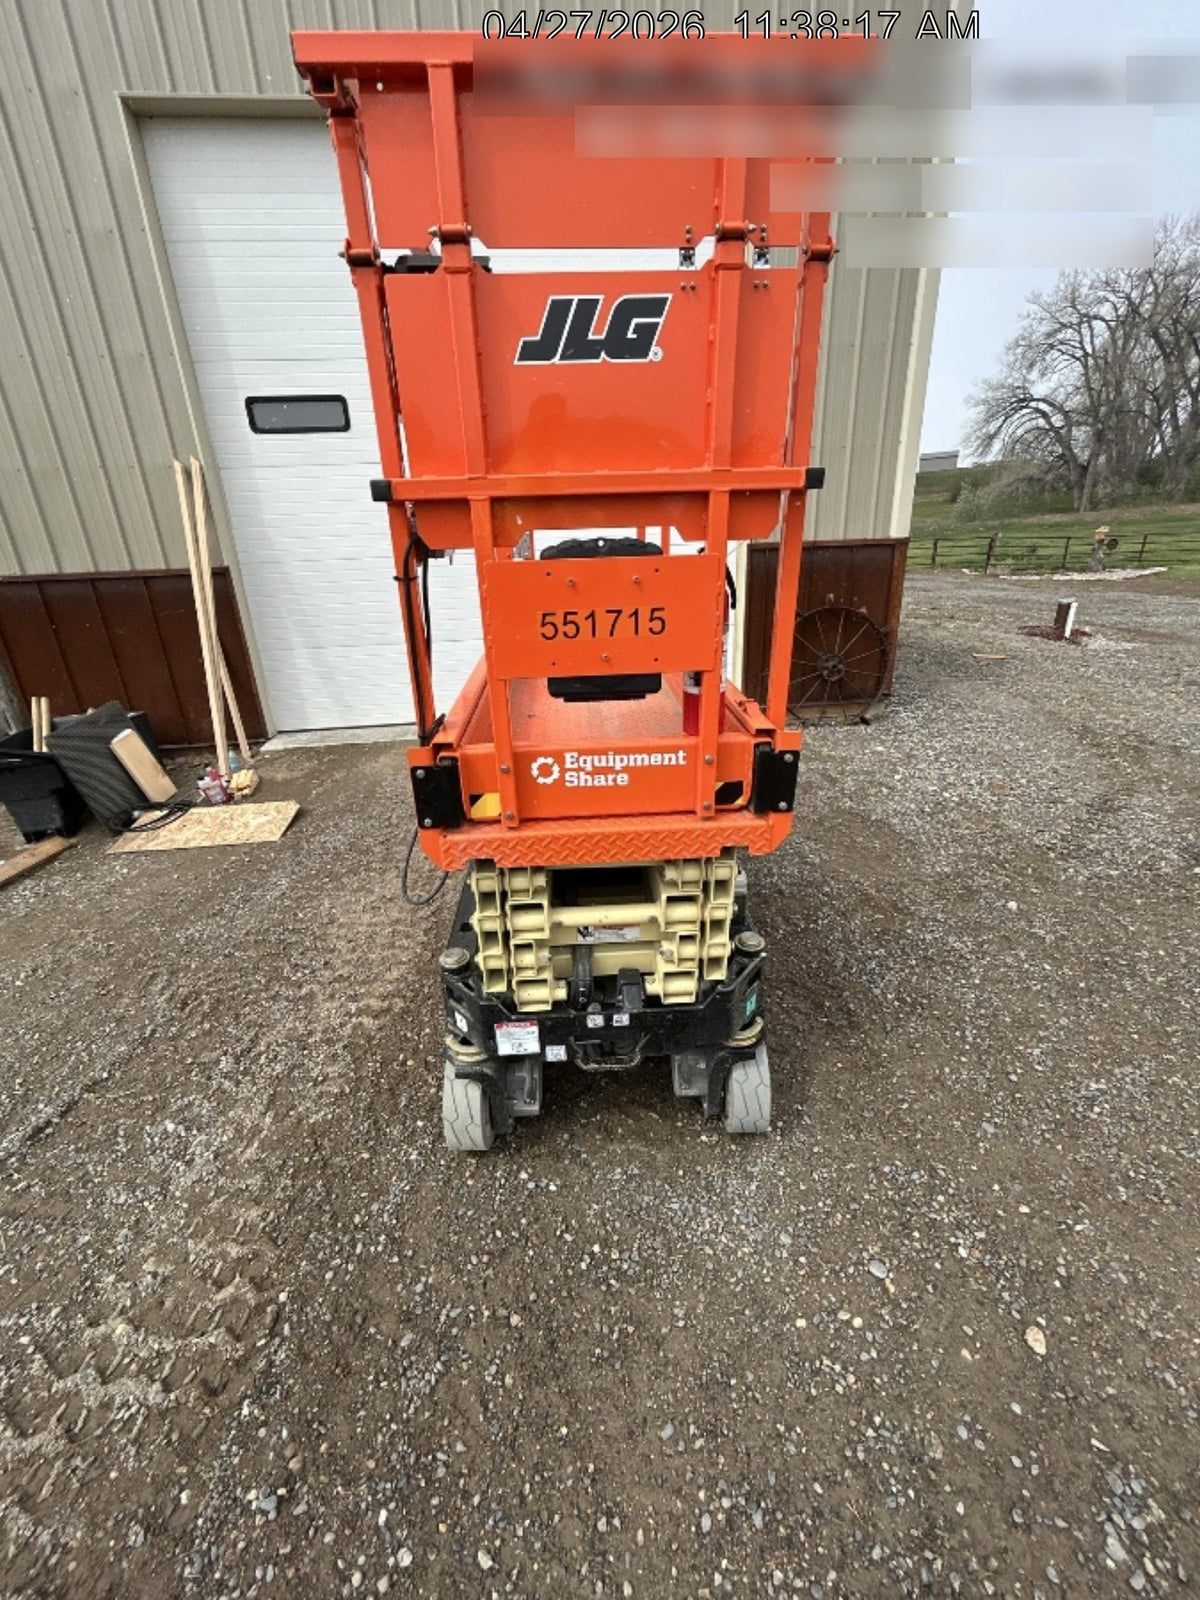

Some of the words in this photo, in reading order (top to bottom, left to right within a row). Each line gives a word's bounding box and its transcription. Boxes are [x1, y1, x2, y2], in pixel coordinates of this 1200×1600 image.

[514, 294, 673, 365] JLG
[540, 607, 666, 640] 551715
[564, 750, 687, 771] Equipment
[564, 771, 629, 787] Share
